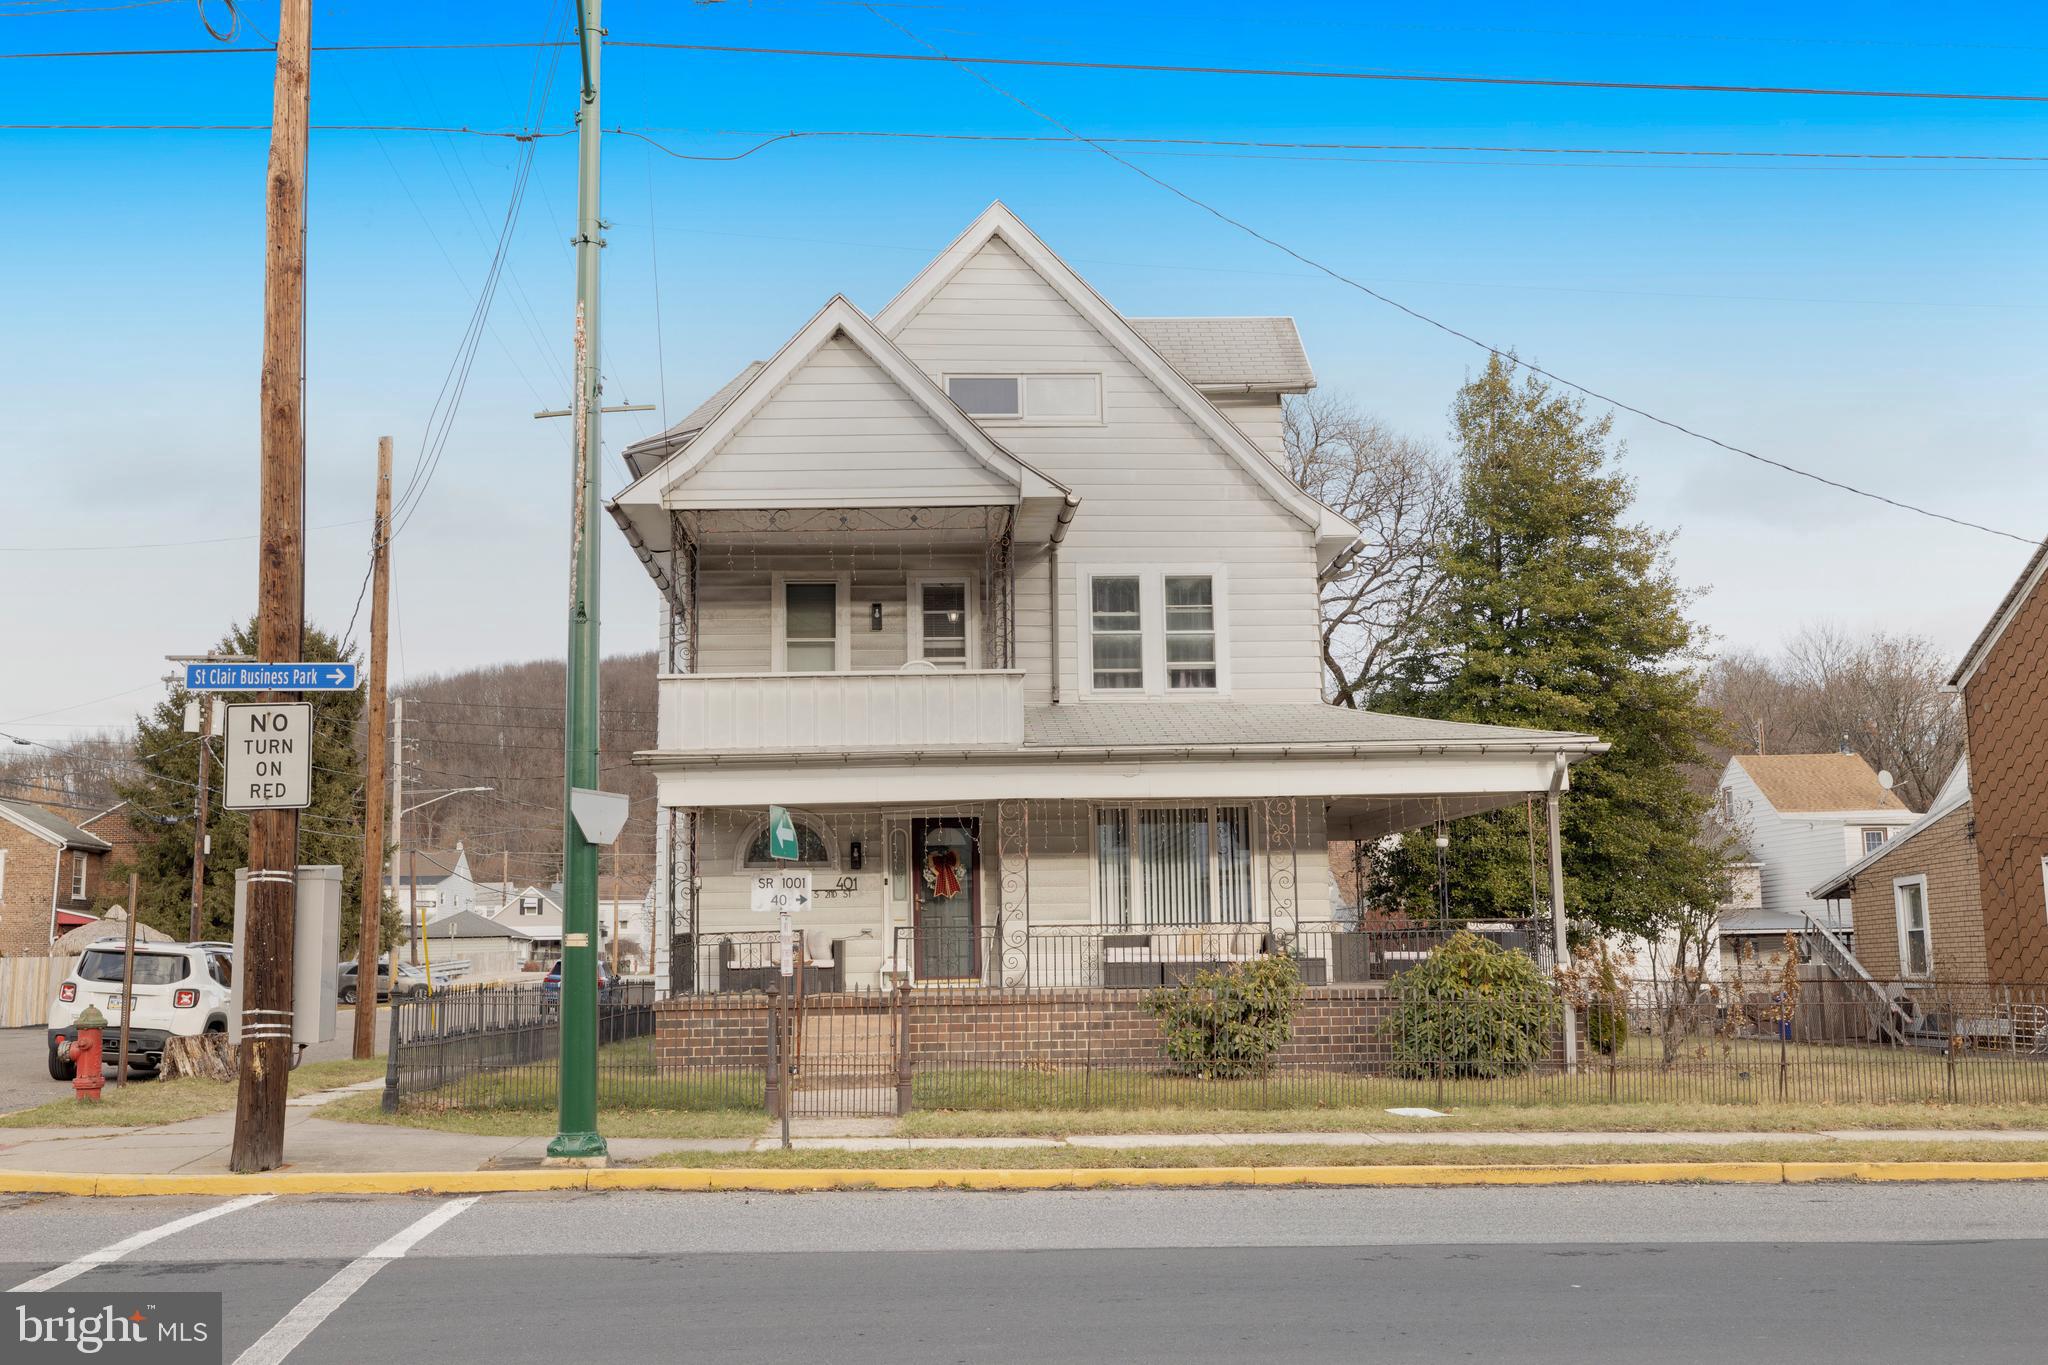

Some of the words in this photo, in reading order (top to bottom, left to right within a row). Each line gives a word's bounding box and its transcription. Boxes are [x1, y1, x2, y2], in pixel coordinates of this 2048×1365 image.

[195, 669, 206, 685] St
[209, 668, 237, 685] Clair
[240, 668, 289, 685] Business
[293, 668, 318, 685] Park
[250, 713, 288, 733] NO
[244, 738, 293, 755] TURN
[256, 761, 282, 777] ON
[250, 783, 287, 799] RED
[758, 877, 774, 889] SR
[782, 877, 806, 889] 1001
[836, 877, 858, 891] 401
[770, 894, 787, 906] 40
